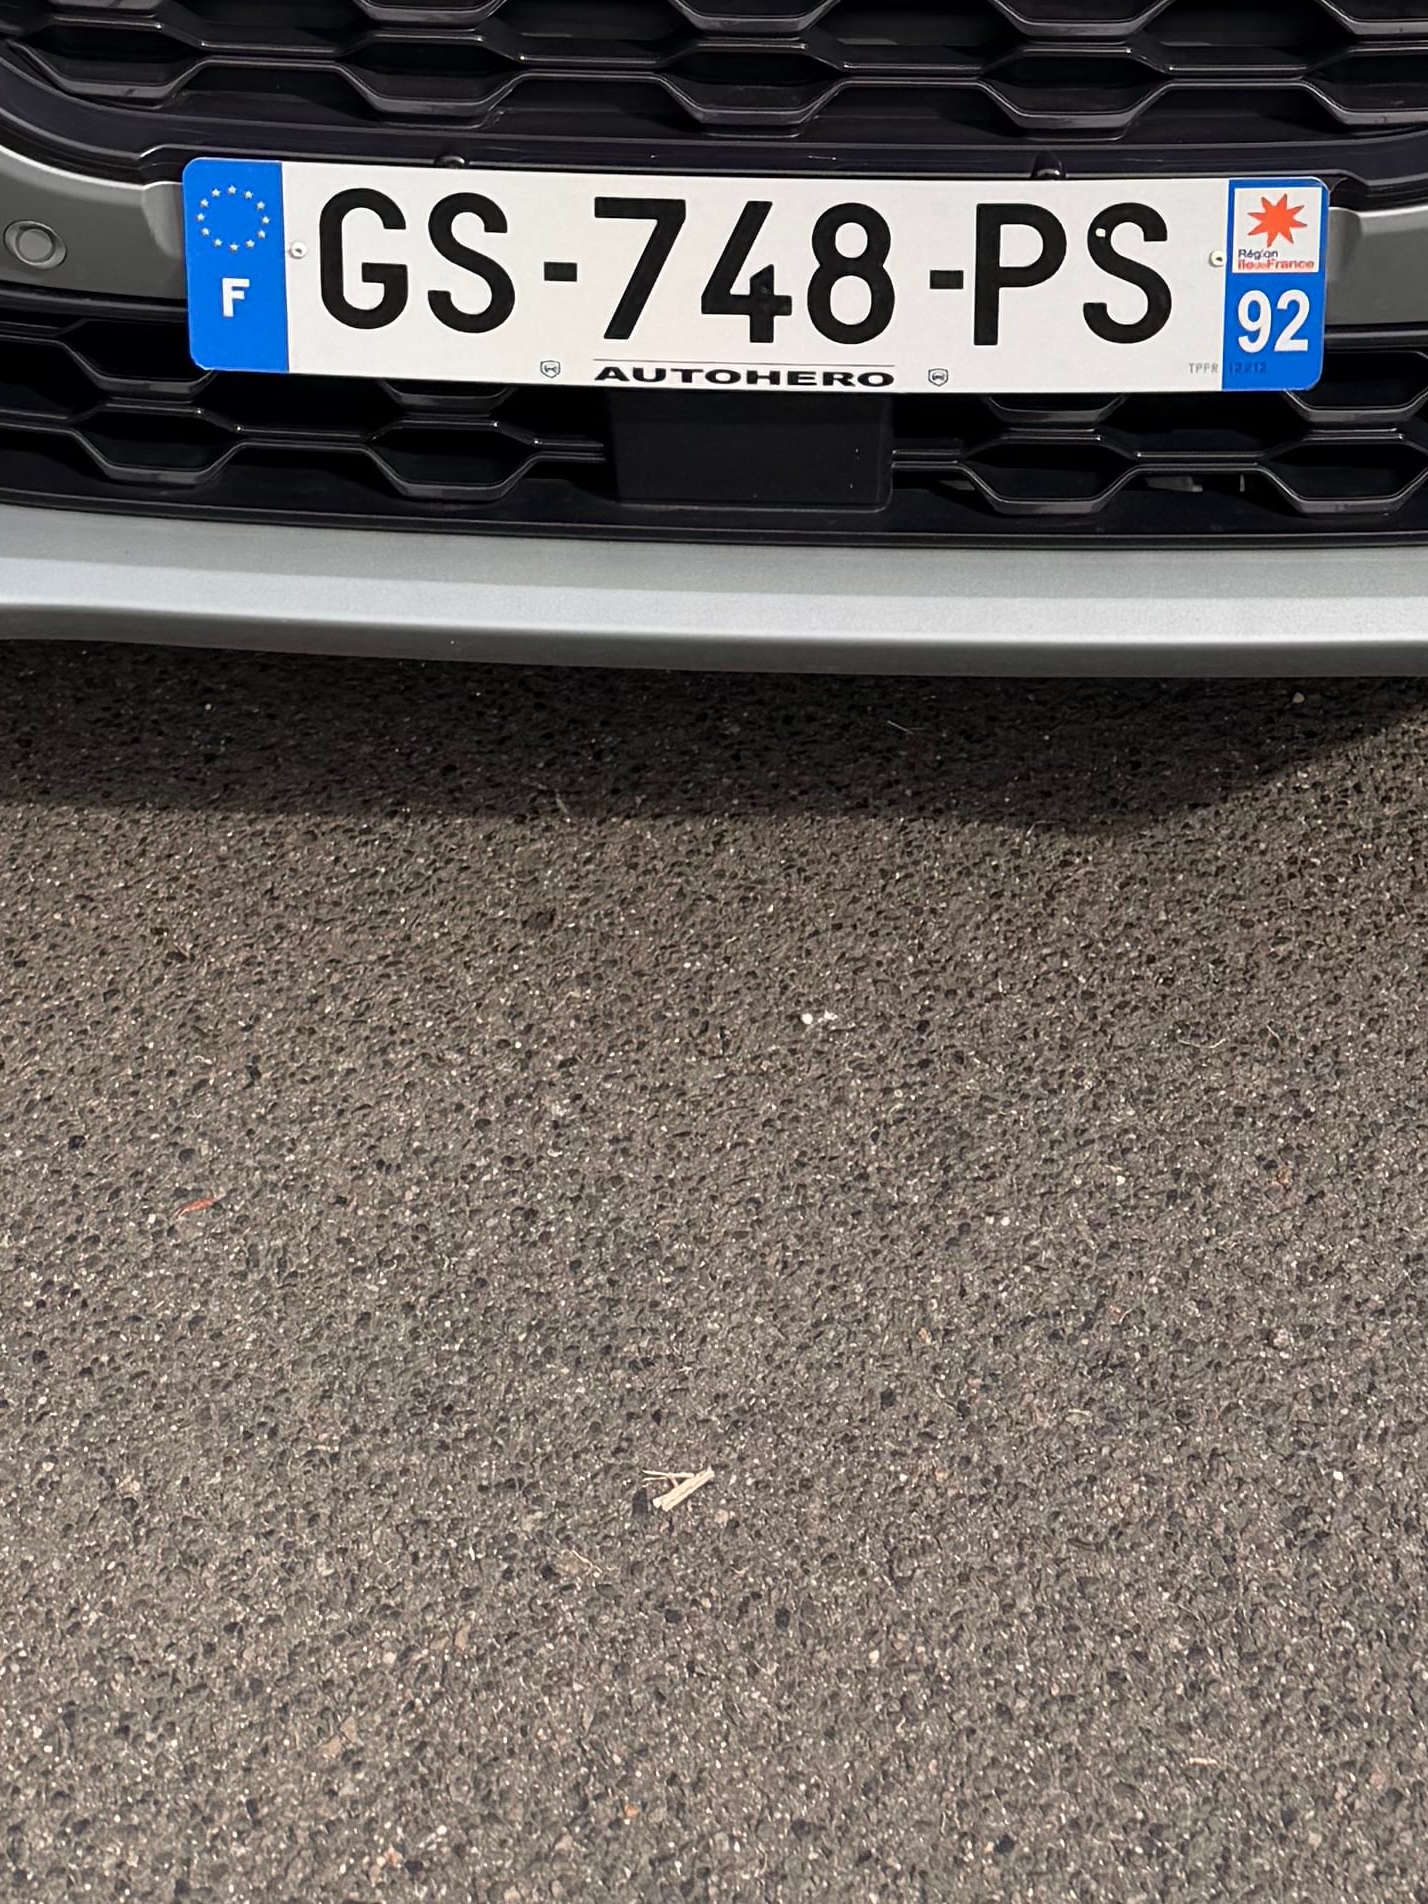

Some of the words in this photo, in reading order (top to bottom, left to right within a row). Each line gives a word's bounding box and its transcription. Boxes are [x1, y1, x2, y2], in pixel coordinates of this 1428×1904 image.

[319, 187, 1172, 346] GS-748-PS
[222, 277, 250, 317] F
[1237, 289, 1311, 353] 92
[594, 366, 894, 388] AUTOHERO
